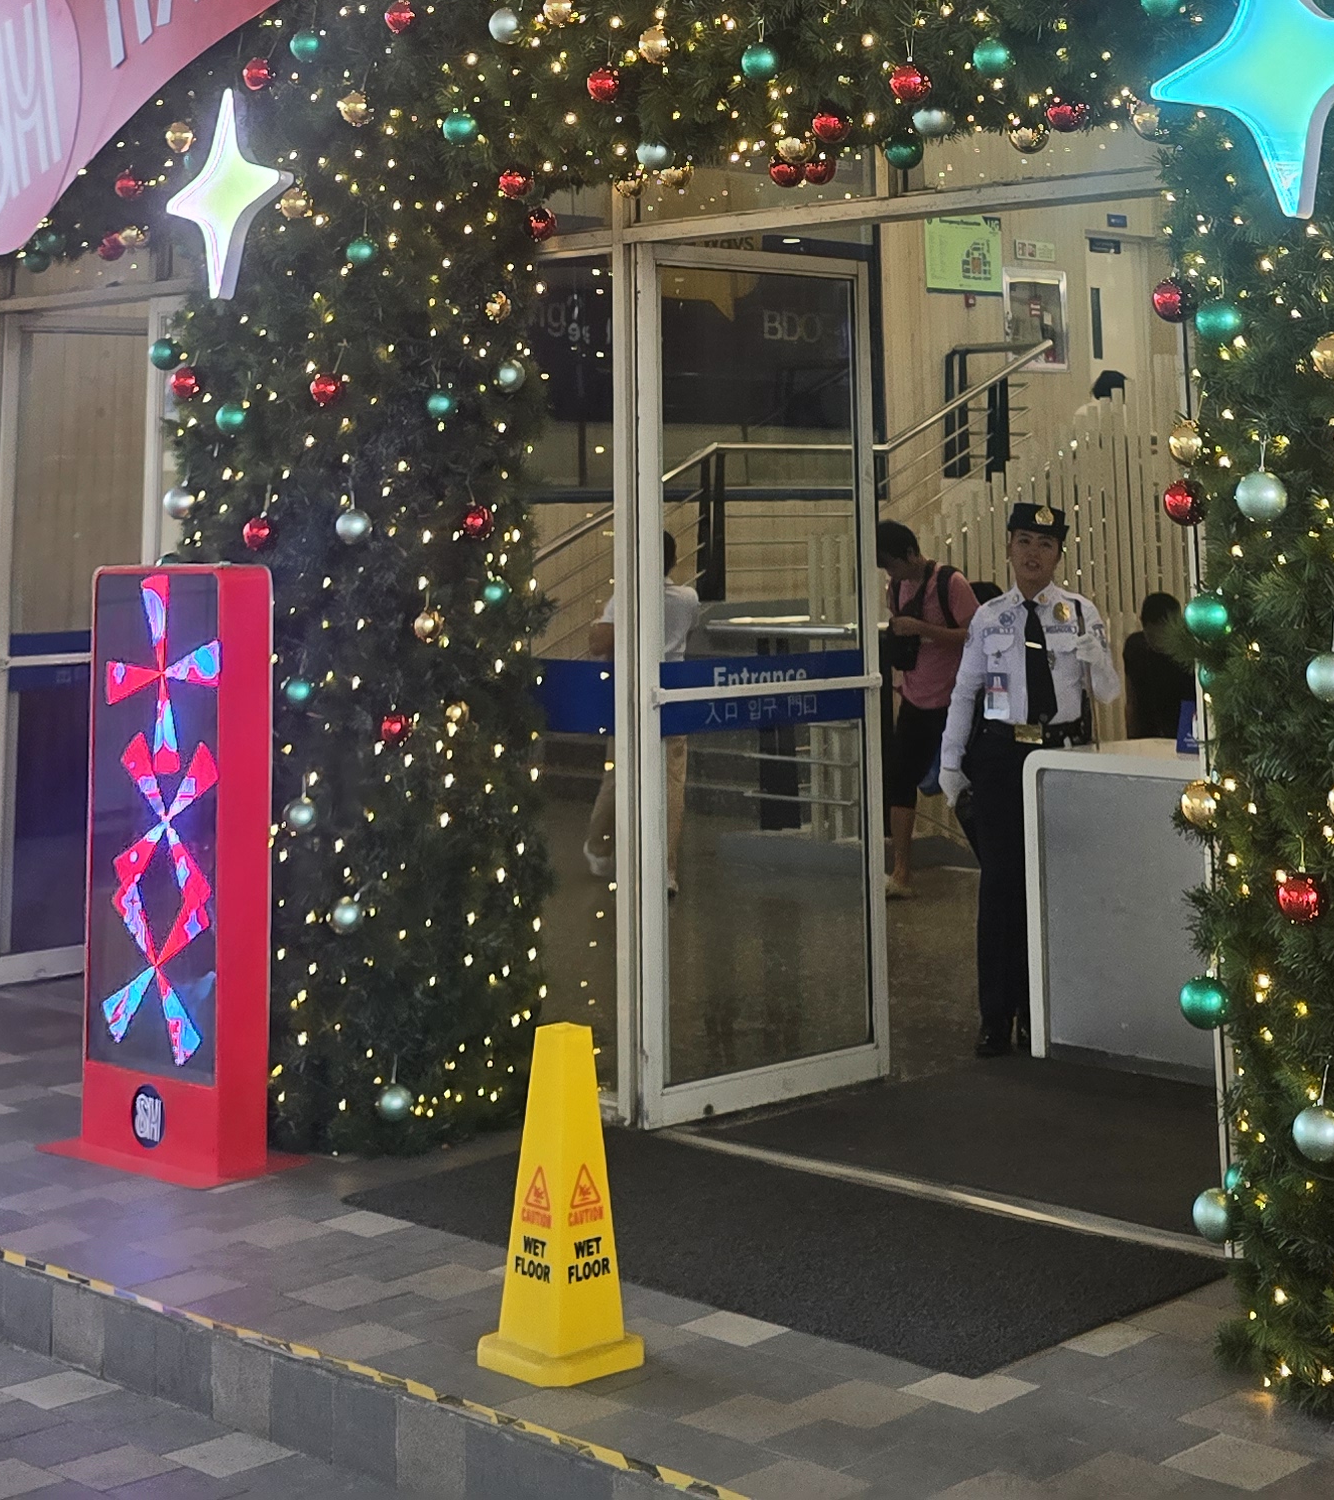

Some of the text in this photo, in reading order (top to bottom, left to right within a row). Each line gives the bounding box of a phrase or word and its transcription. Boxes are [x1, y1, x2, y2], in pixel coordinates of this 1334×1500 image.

[763, 309, 821, 343] BDO
[713, 666, 807, 687] Entrance
[523, 1235, 547, 1258] WET
[574, 1236, 602, 1259] WET
[514, 1255, 551, 1284] FLOOR
[567, 1256, 611, 1284] FLOOR
